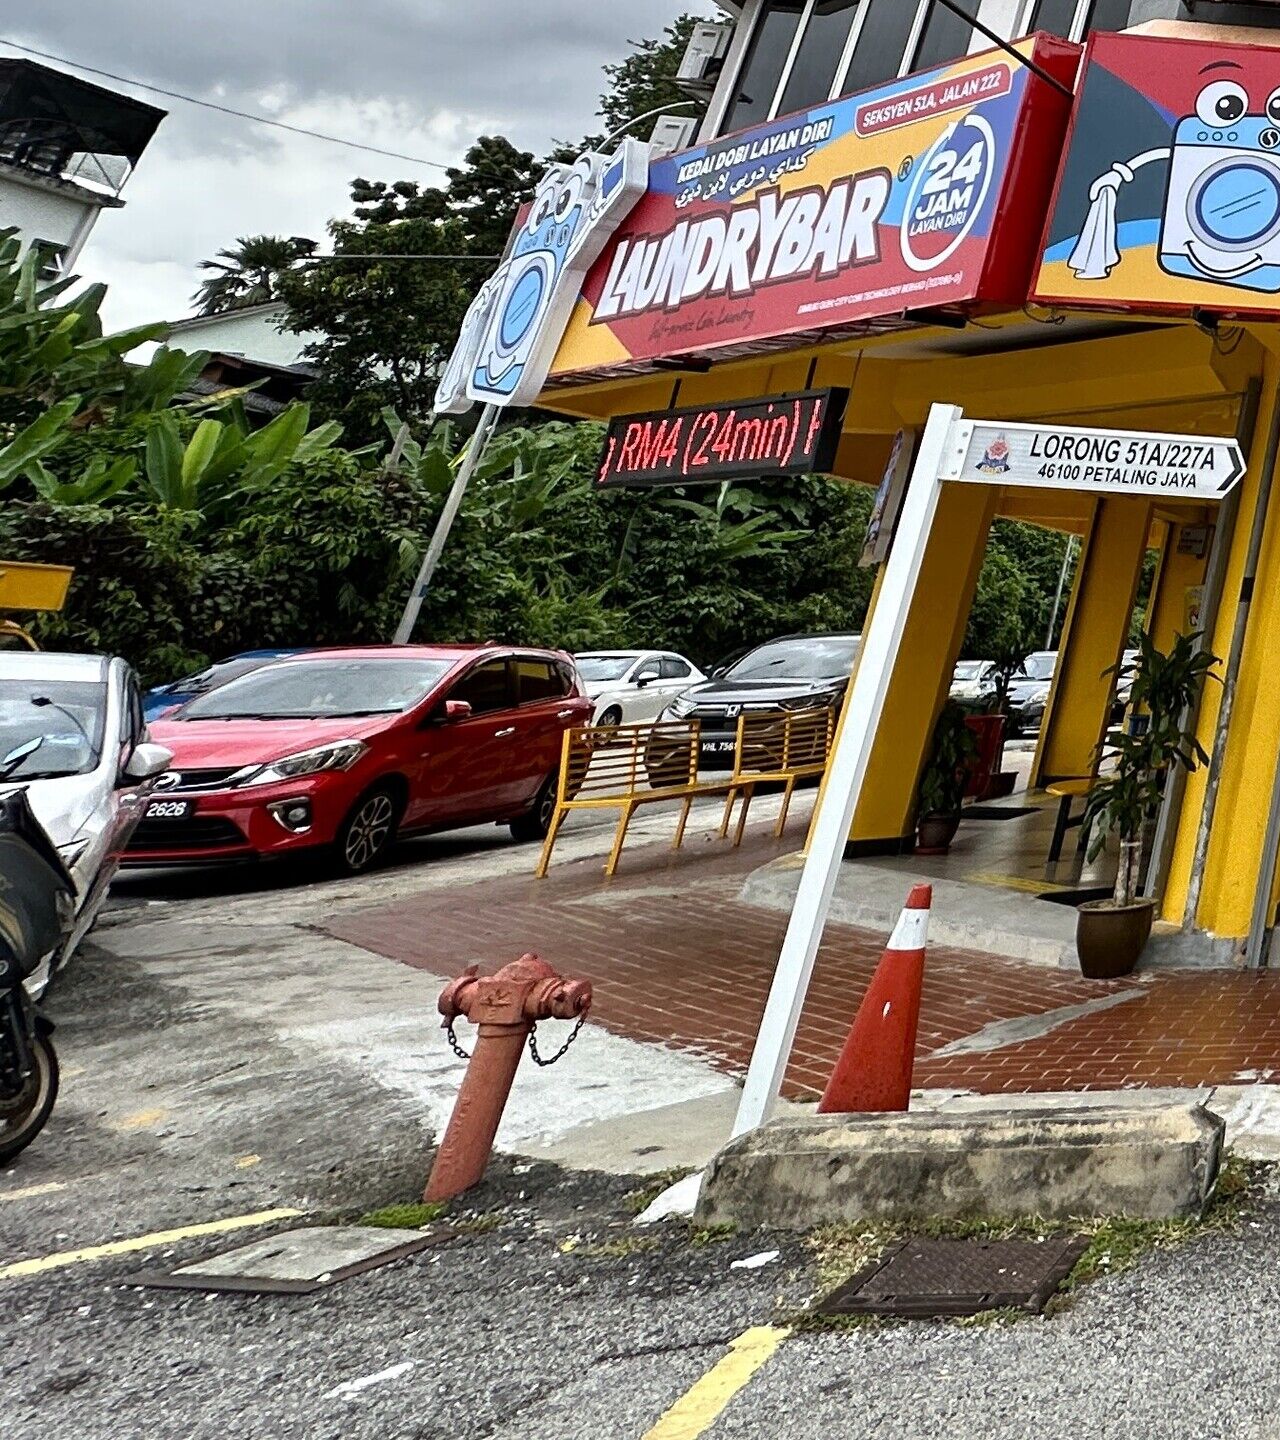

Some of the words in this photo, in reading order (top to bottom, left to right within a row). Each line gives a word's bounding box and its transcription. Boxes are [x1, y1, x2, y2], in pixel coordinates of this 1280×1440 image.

[861, 102, 912, 128] SEKSYEN
[939, 80, 978, 110] JALAN
[979, 70, 1002, 94] 222
[676, 156, 715, 185] KEDAI
[714, 145, 748, 172] DOBI
[749, 129, 799, 164] LAYAN
[799, 115, 835, 144] DIRI
[921, 141, 985, 195] 24
[909, 219, 944, 237] LAYAN
[943, 211, 966, 229] DIRI
[915, 186, 974, 220] JAM
[592, 172, 887, 323] LAUNDRYBAR
[615, 417, 684, 473] RM4
[682, 399, 801, 476] (24min)
[1029, 433, 1121, 463] LORONG
[1124, 441, 1216, 471] 51A/227A
[1037, 462, 1080, 481] 46100
[1083, 465, 1158, 486] PETALING
[1160, 470, 1197, 488] JAYA
